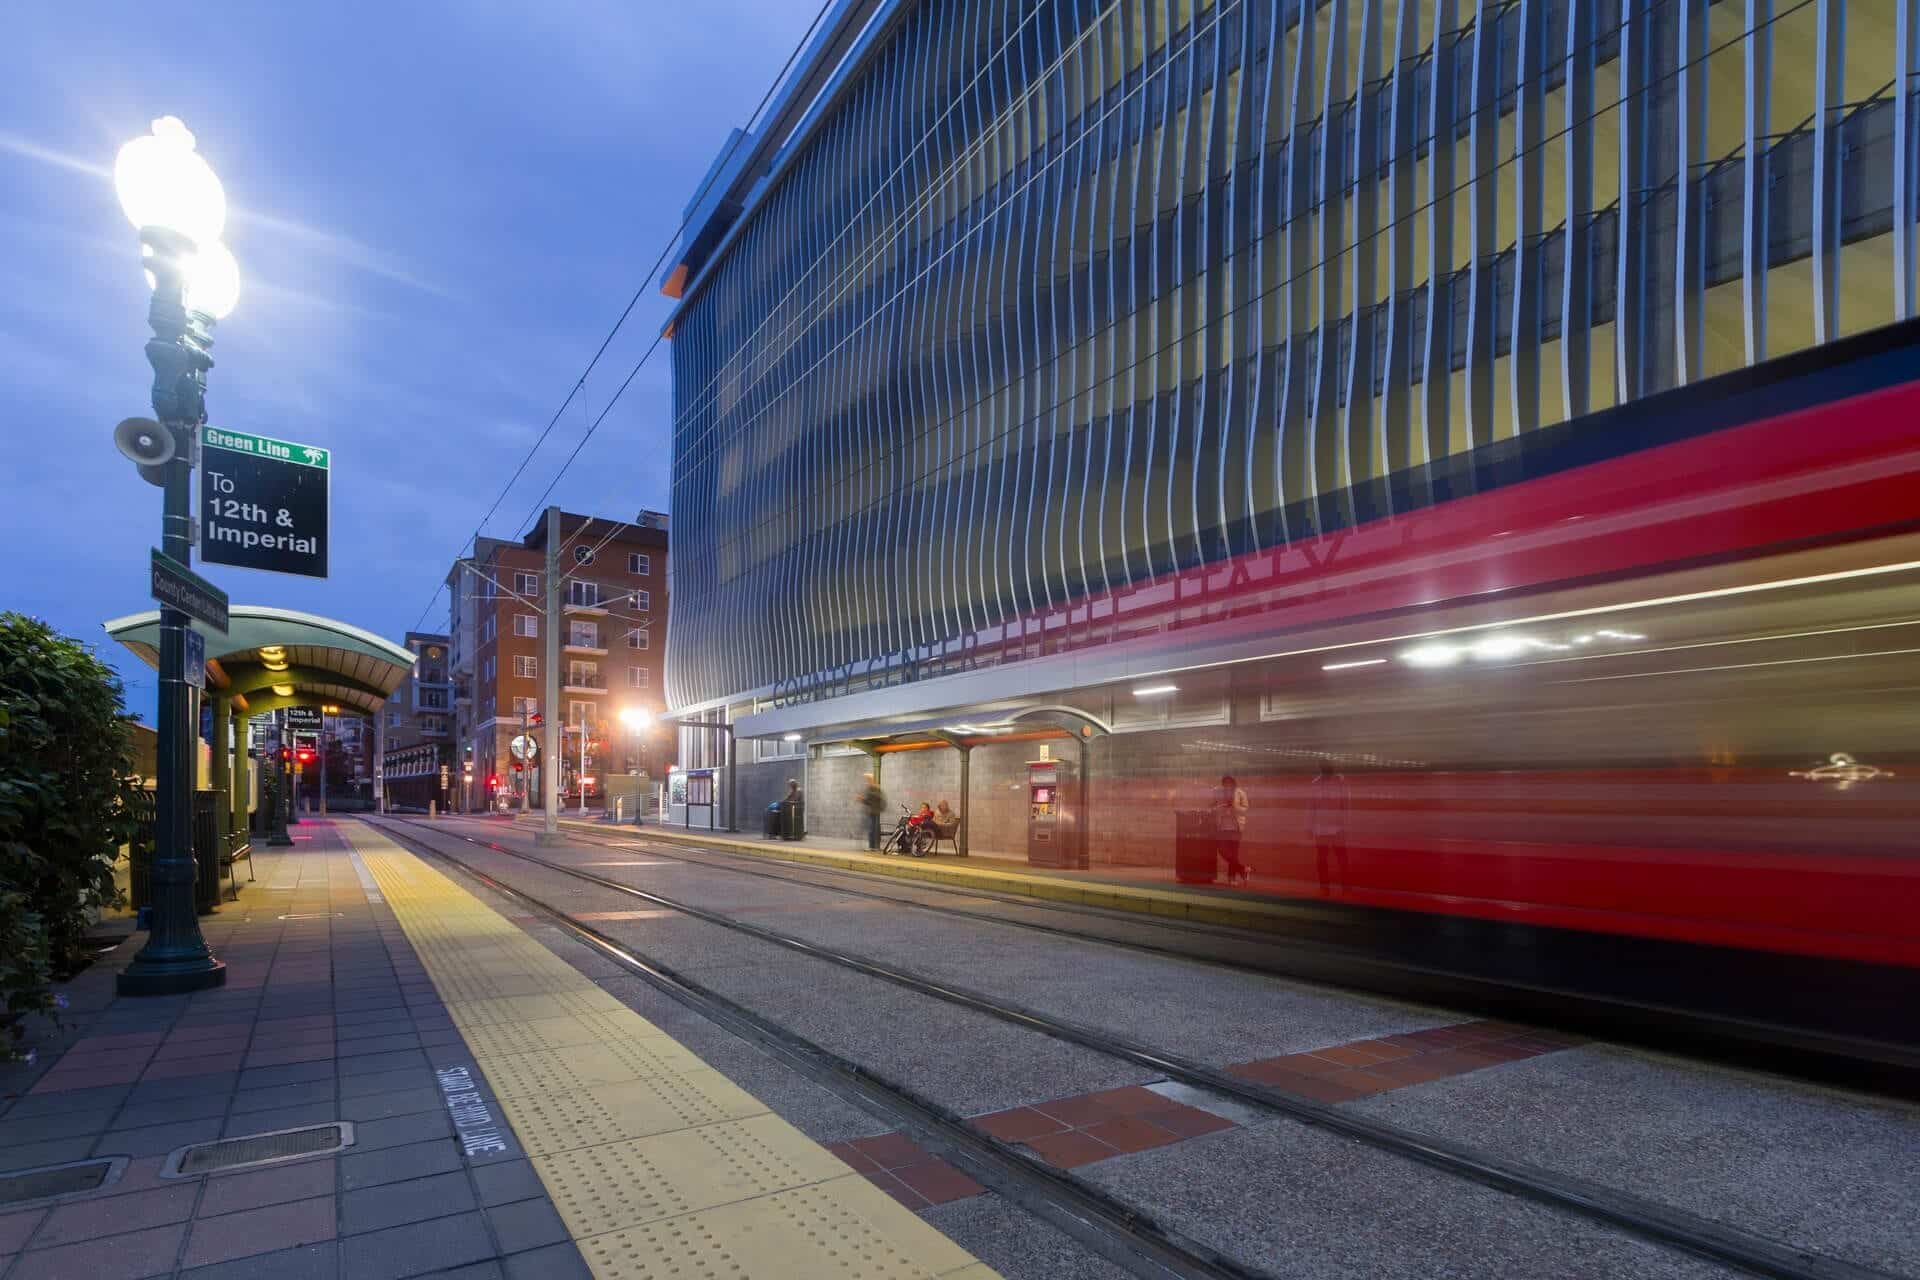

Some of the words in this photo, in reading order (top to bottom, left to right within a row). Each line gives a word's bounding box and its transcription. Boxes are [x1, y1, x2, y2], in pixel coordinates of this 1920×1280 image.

[207, 429, 253, 451] Green
[258, 439, 290, 458] Line
[207, 471, 235, 494] To
[209, 498, 267, 524] 12th
[275, 508, 295, 528] &
[209, 520, 317, 555] Imperial
[773, 659, 855, 709] COUNTY
[867, 630, 979, 690] CENTER
